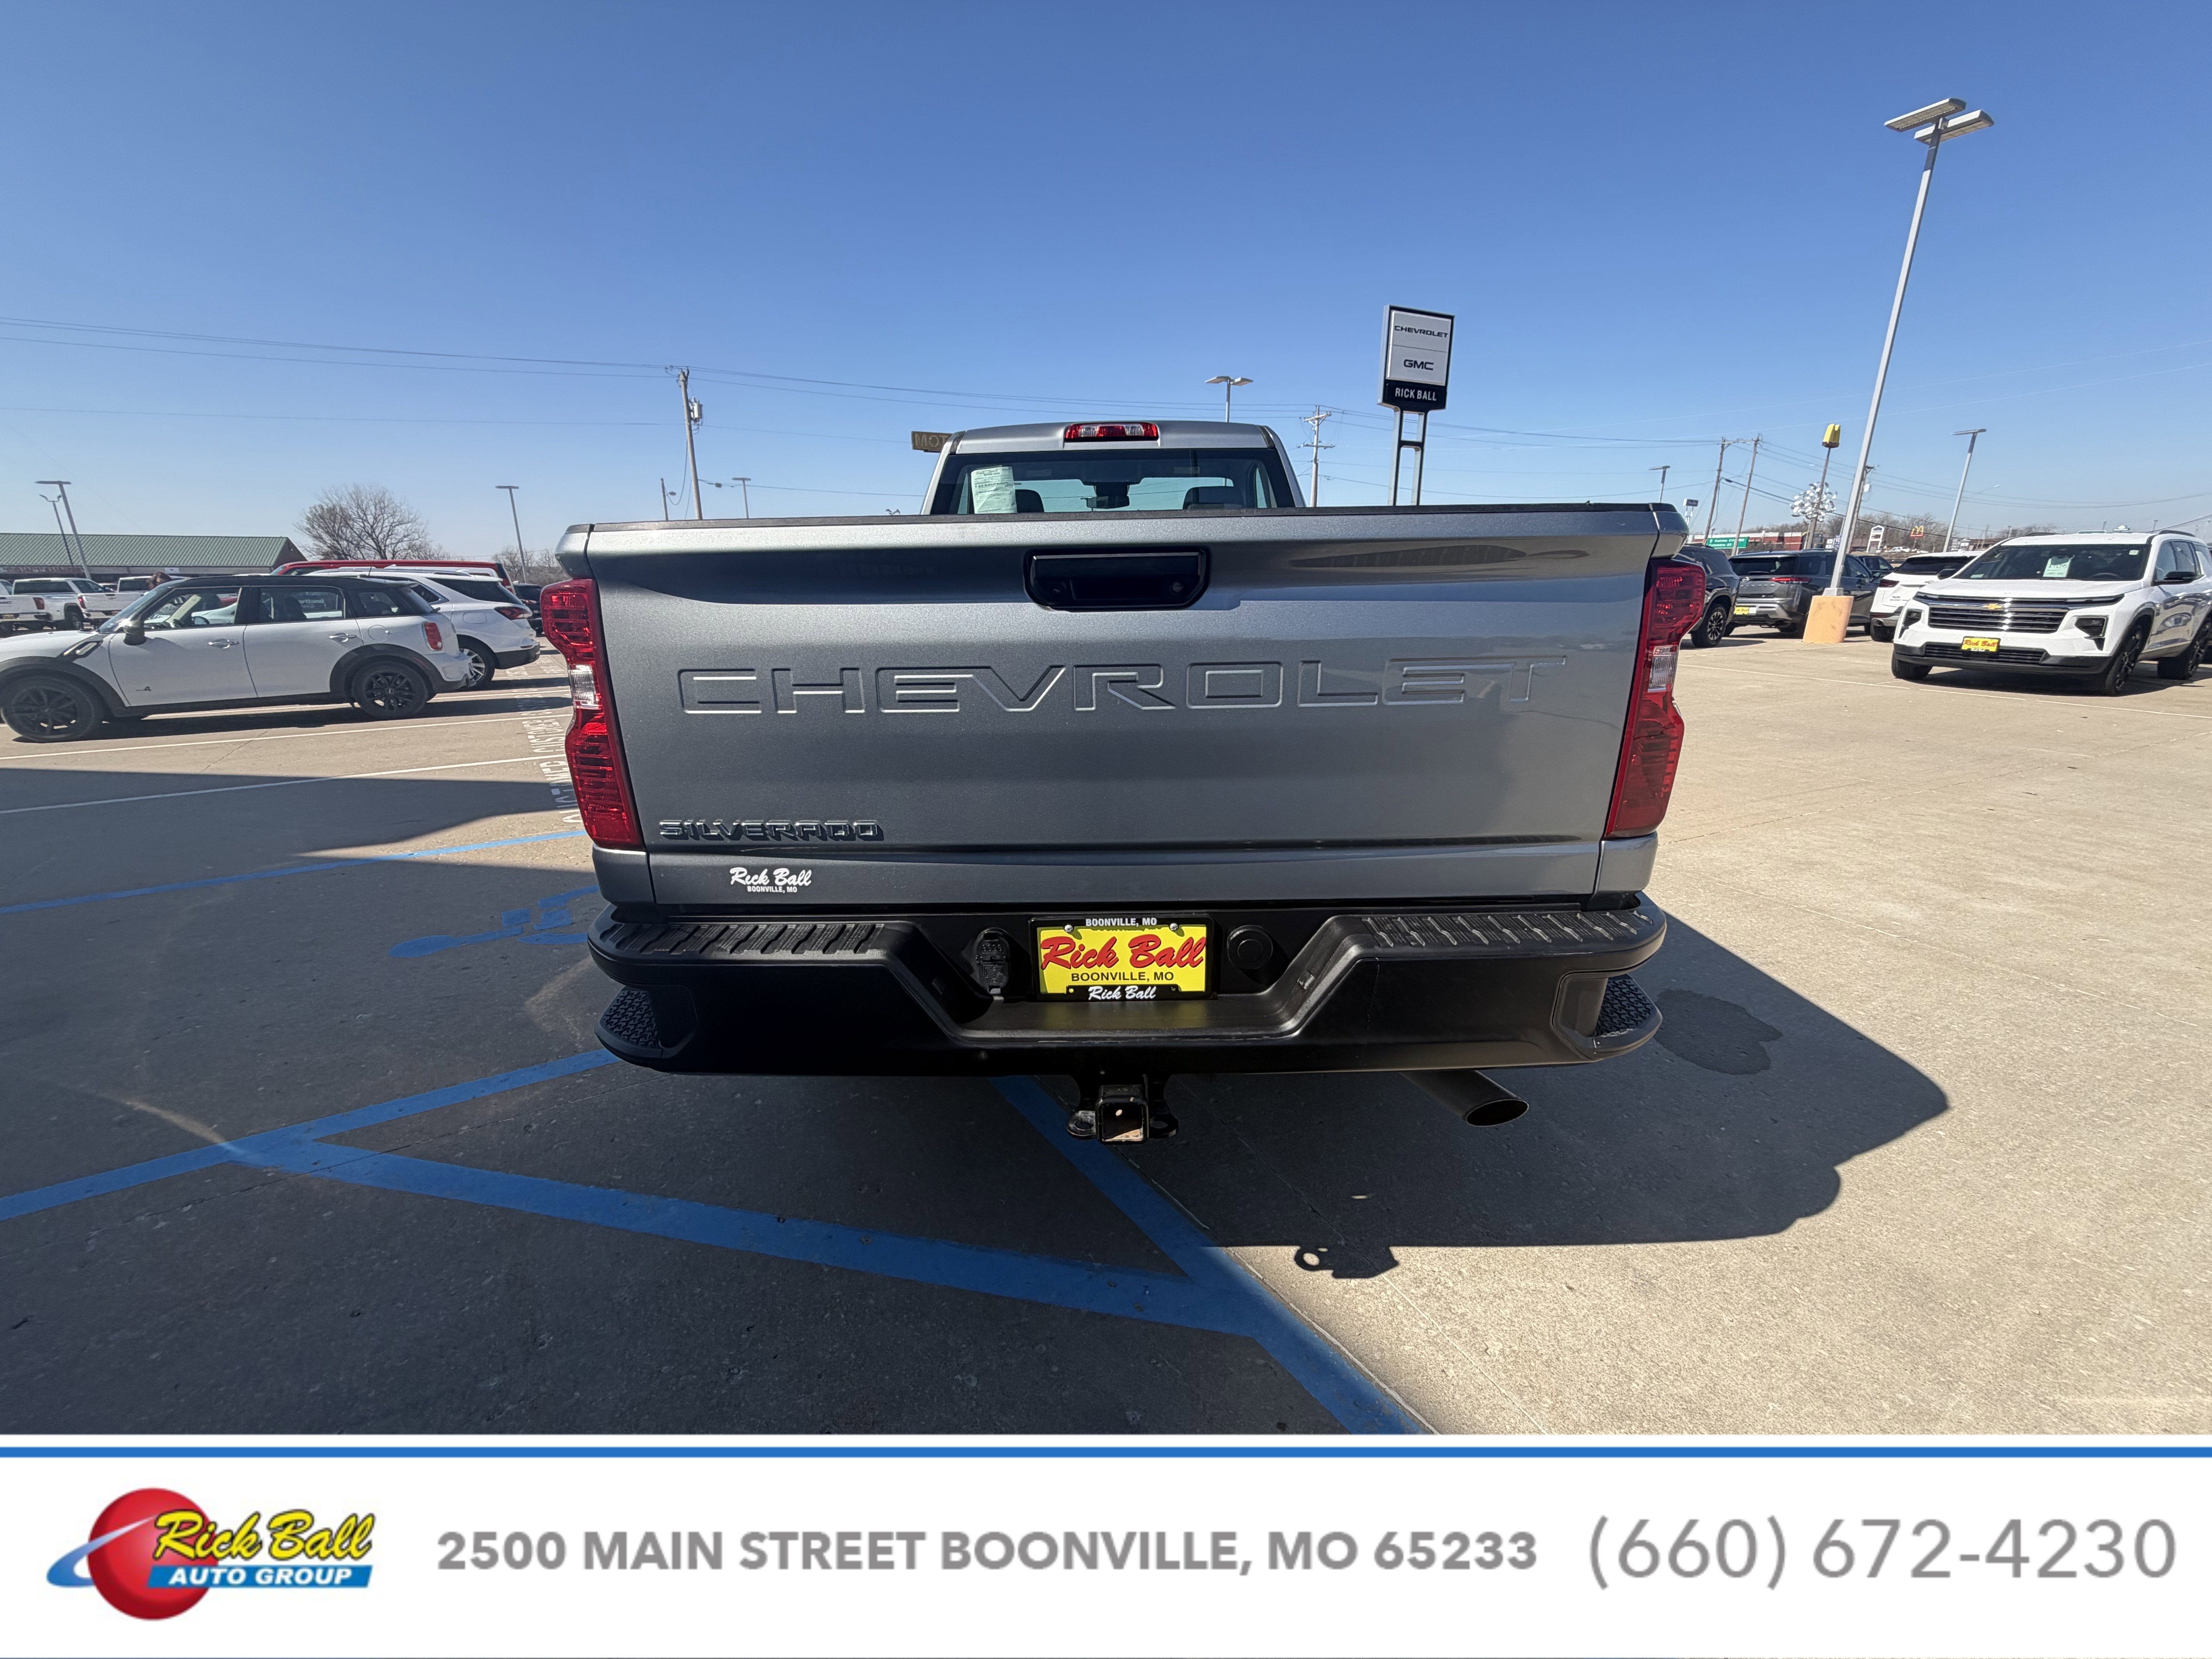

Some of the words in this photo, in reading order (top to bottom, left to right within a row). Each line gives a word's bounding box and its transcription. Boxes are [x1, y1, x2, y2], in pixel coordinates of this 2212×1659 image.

[1394, 325, 1448, 338] CHEVROLET
[1403, 359, 1434, 371] GMC
[1395, 387, 1415, 399] RICK
[1417, 390, 1437, 401] BALL
[915, 434, 949, 447] MOT
[678, 655, 1566, 714] CHEVROLET
[659, 819, 879, 837] SILVERADO
[730, 867, 769, 886] Rick
[773, 867, 812, 886] Ball
[1085, 918, 1139, 927] BOONVILLE,
[1142, 917, 1157, 926] MO
[1041, 936, 1119, 970] Rick
[1128, 934, 1206, 968] Ball
[1072, 972, 1149, 982] BOONVILLE,
[1154, 972, 1174, 981] MO
[1088, 986, 1122, 1000] Rick
[1125, 986, 1156, 1000] Ball
